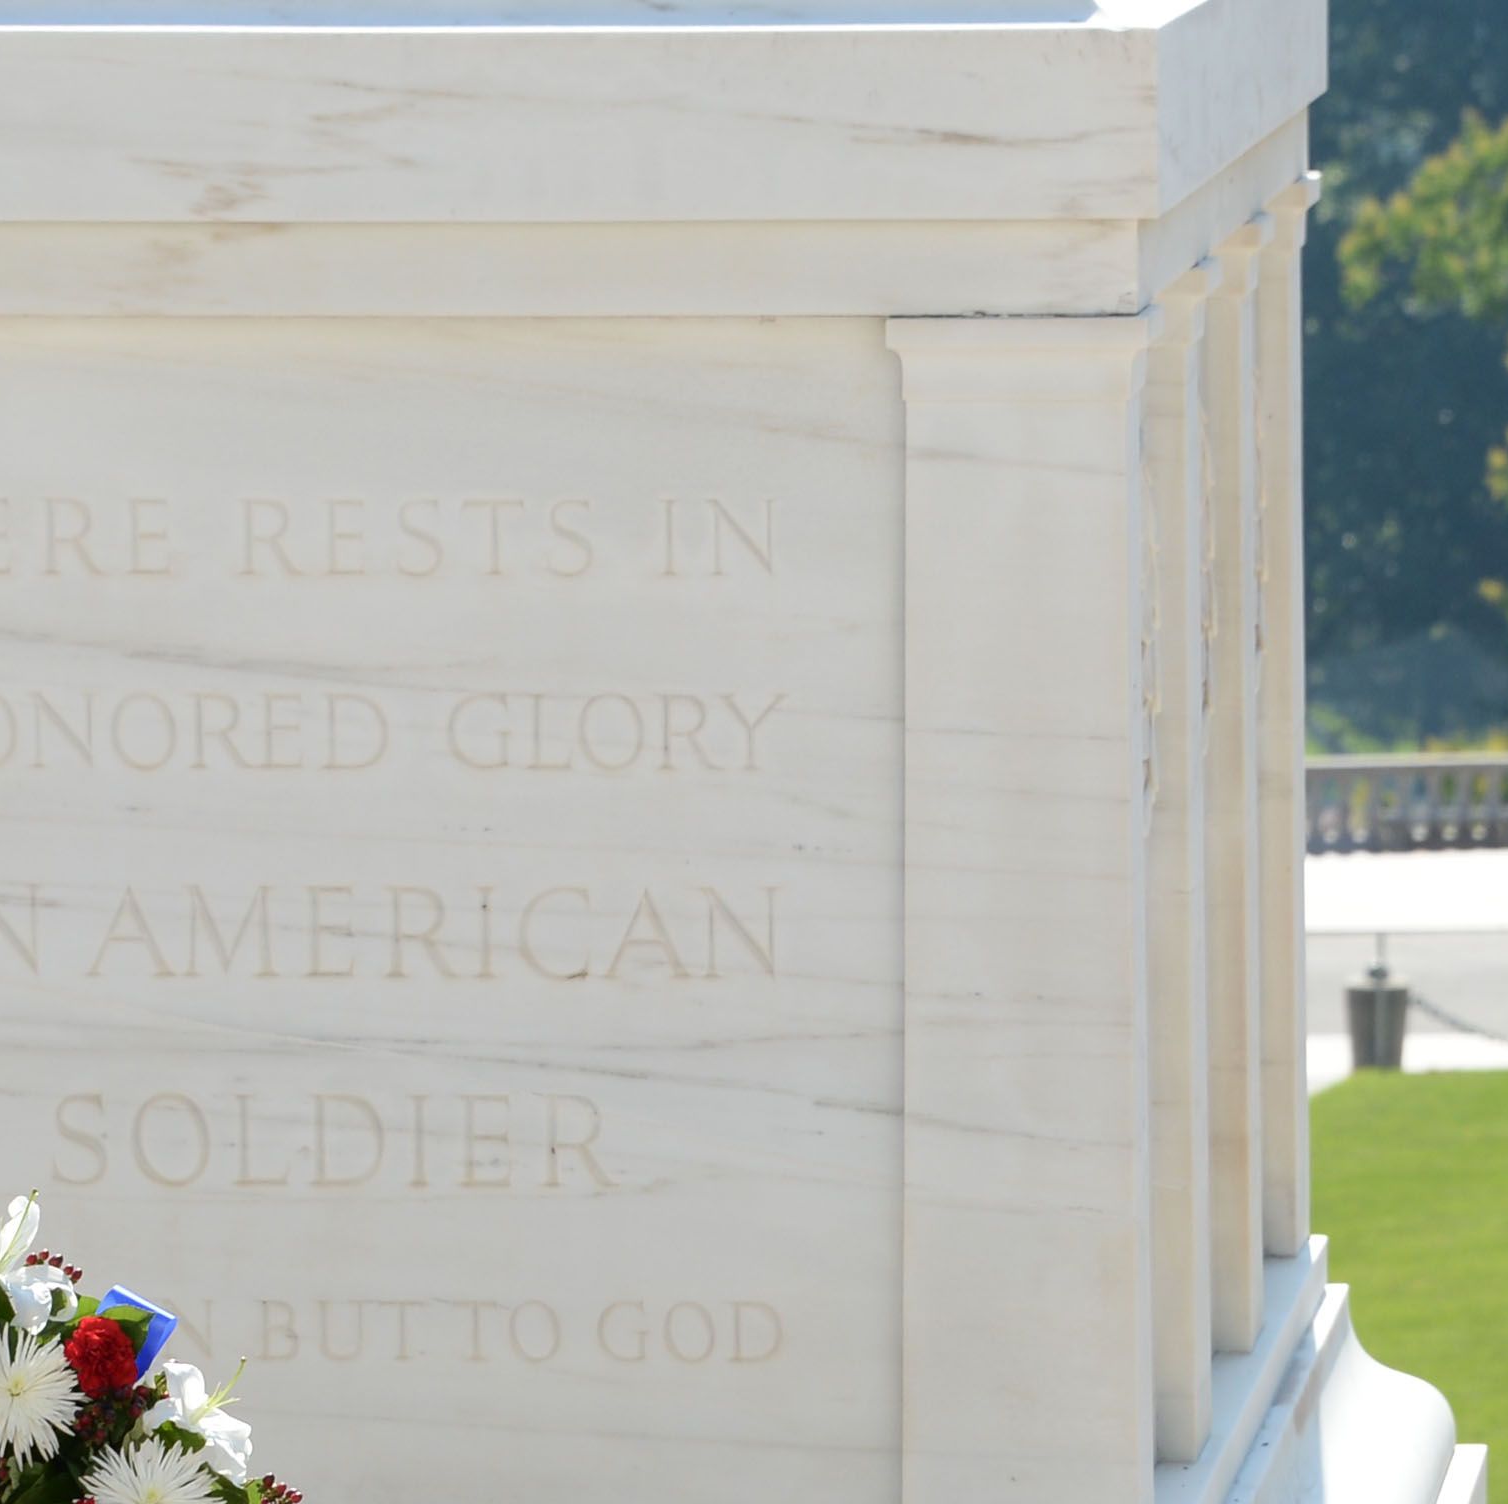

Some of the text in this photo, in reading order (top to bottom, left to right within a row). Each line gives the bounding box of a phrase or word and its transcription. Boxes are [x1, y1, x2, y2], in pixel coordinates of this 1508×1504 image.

[237, 497, 597, 580] RESTS
[658, 496, 781, 579] IN
[446, 690, 791, 774] GLORY
[85, 882, 785, 982] AMERICAN
[50, 1089, 620, 1191] SOLDIER
[254, 1297, 425, 1365] BUT
[453, 1297, 563, 1366] TO
[595, 1298, 787, 1367] GOD
